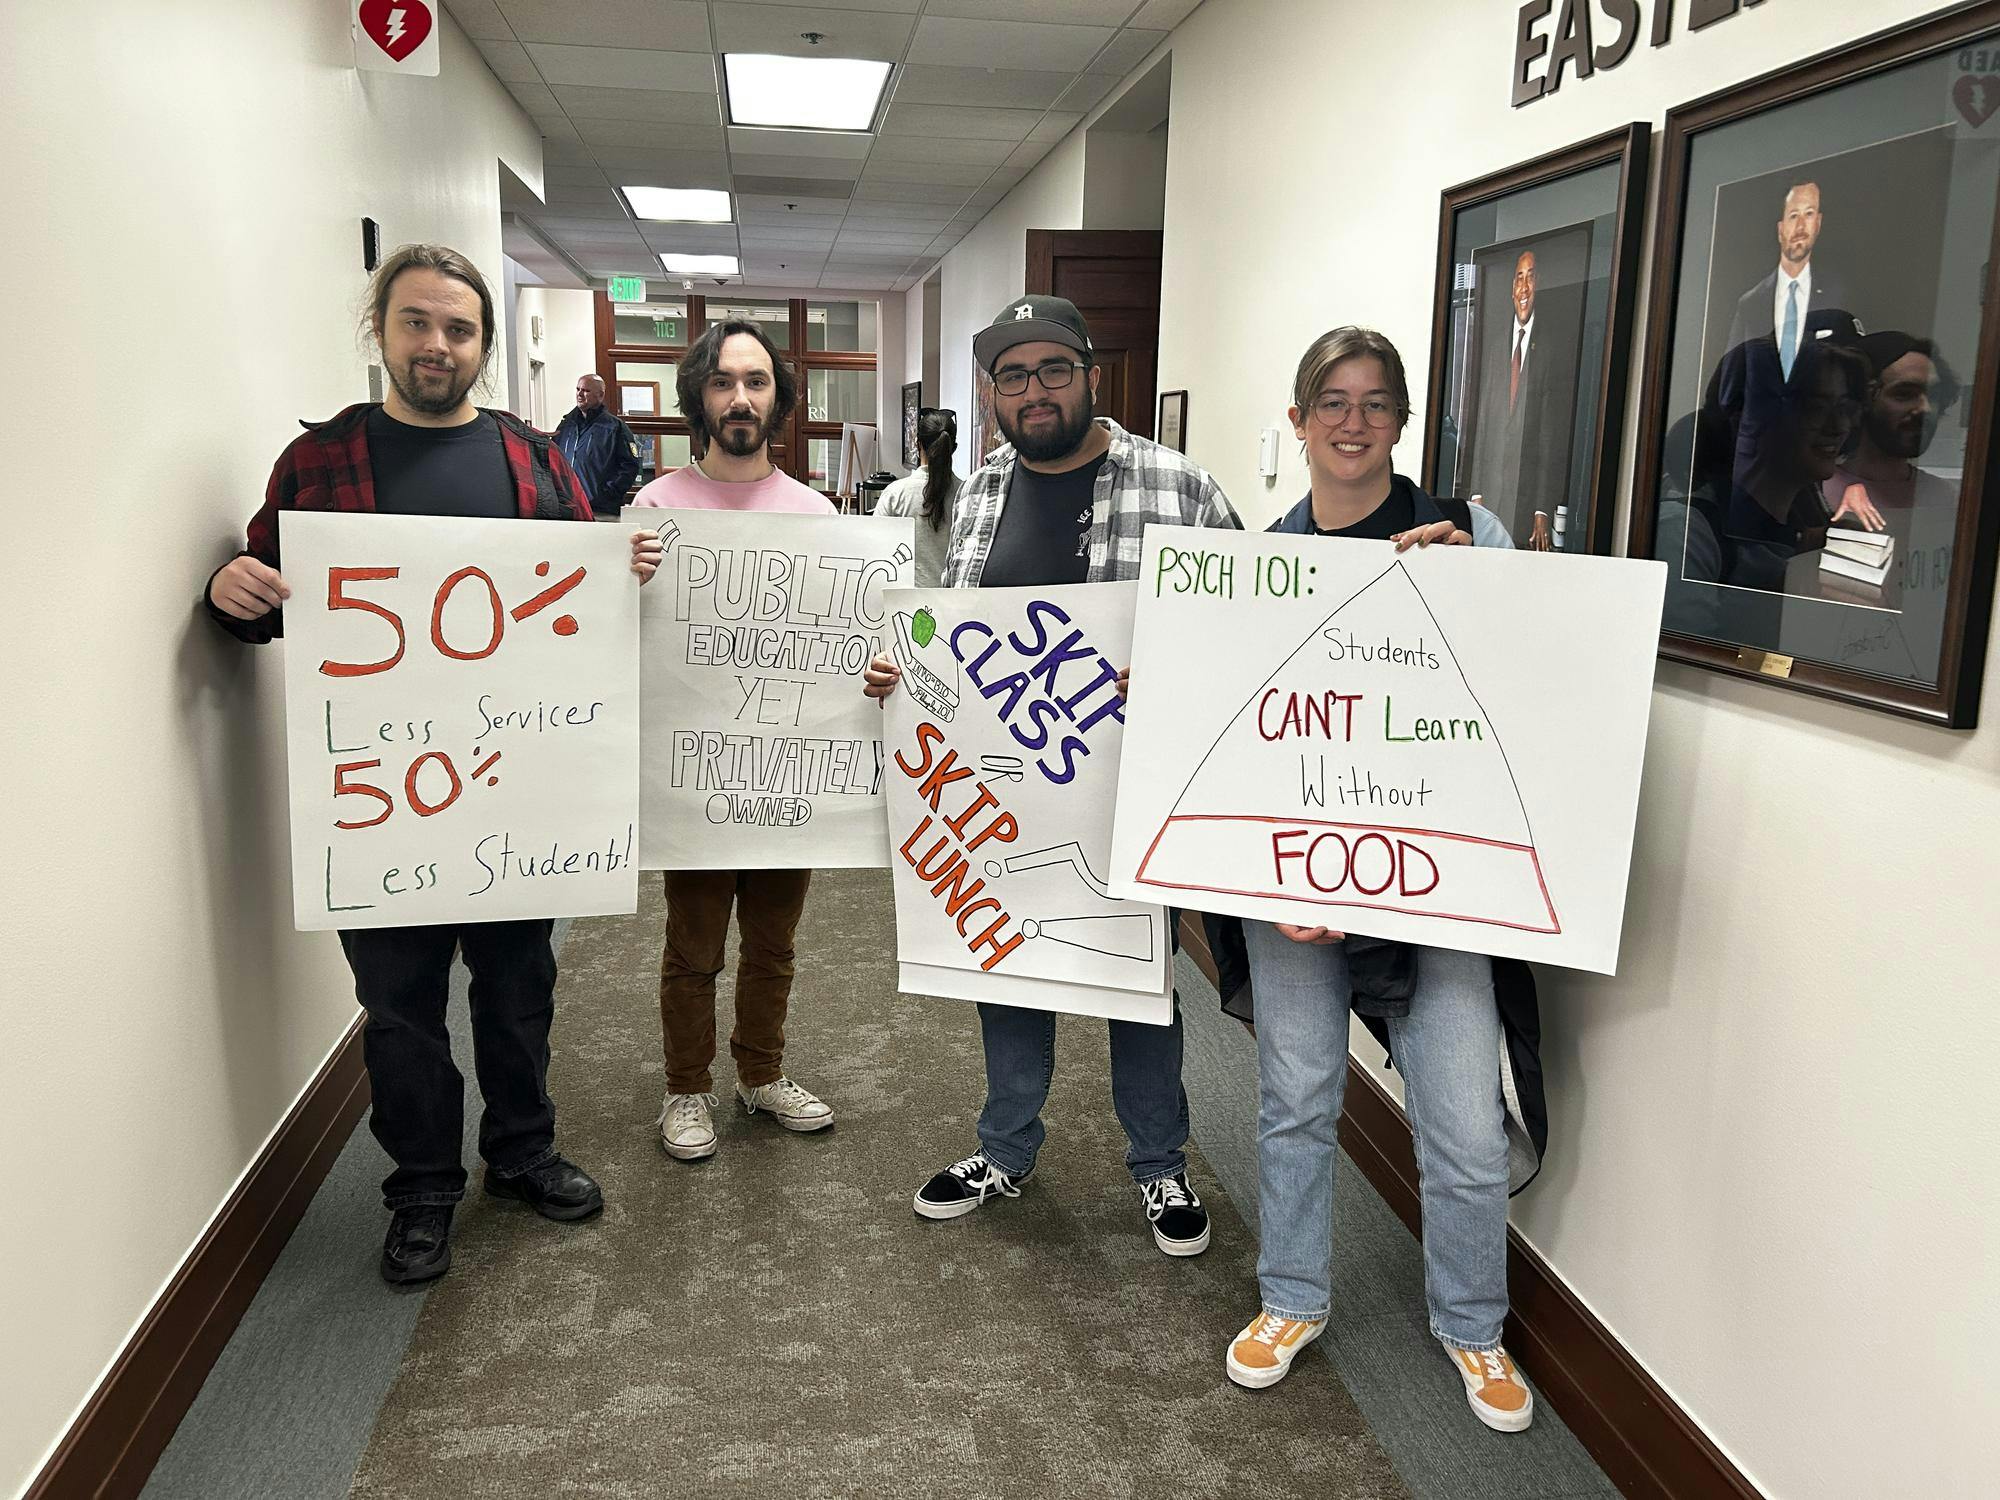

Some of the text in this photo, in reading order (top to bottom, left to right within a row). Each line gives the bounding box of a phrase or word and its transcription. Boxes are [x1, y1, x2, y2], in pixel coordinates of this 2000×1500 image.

[613, 277, 641, 301] EXIT
[1156, 546, 1317, 599] PSYCH 101:
[319, 561, 587, 677] 50%
[1323, 628, 1440, 669] Students
[326, 695, 603, 753] Less Services
[734, 675, 816, 727] YET
[950, 620, 1089, 784] CLASS
[1257, 688, 1483, 742] CAN'T Learn
[334, 746, 502, 829] 50%
[894, 722, 1019, 853] SKIP
[980, 754, 1024, 783] OR
[1301, 755, 1433, 808] Without
[706, 793, 812, 827] OWNED
[326, 824, 632, 911] Less Students!
[1271, 829, 1440, 896] FOOD
[899, 814, 1025, 971] LUNCH
